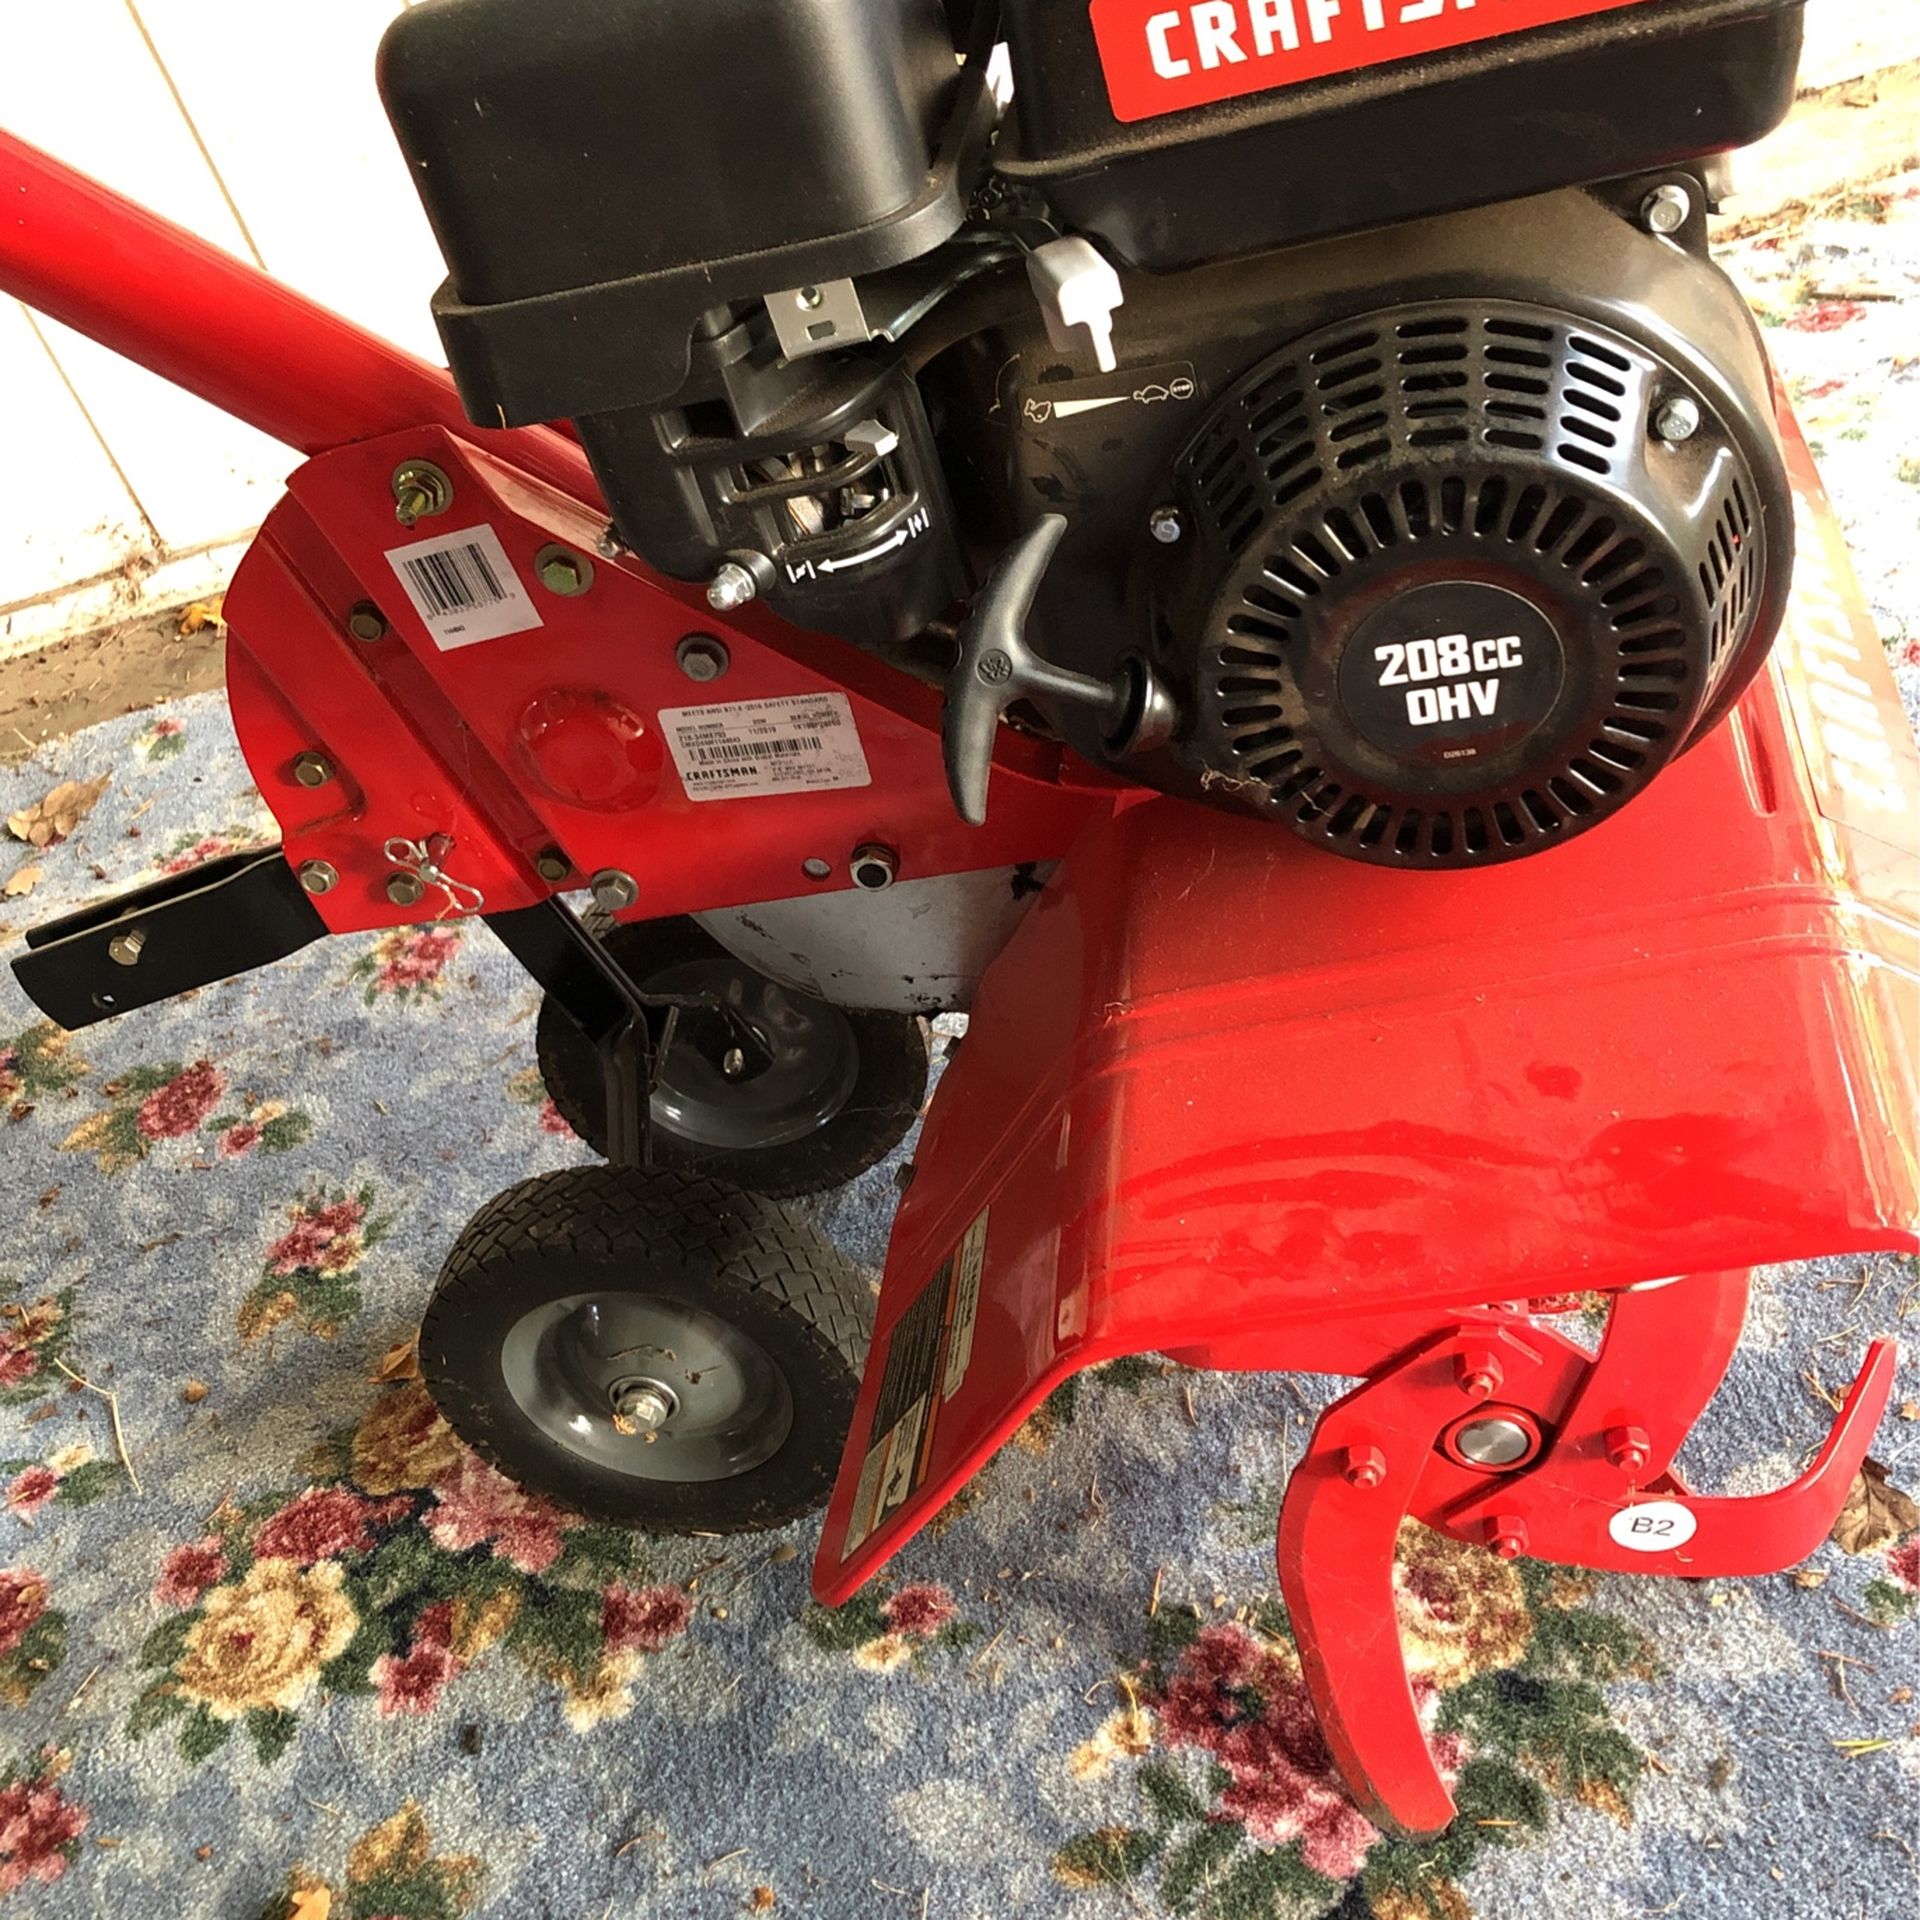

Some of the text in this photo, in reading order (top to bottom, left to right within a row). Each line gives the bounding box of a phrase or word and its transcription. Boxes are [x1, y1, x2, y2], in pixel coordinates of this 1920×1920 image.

[1145, 0, 1477, 79] CRAF
[764, 700, 789, 709] SAFETY
[791, 696, 828, 706] STANDARD
[1406, 678, 1499, 726] OHV
[686, 766, 758, 781] CRAFTSMAN
[1632, 1516, 1675, 1536] B2
